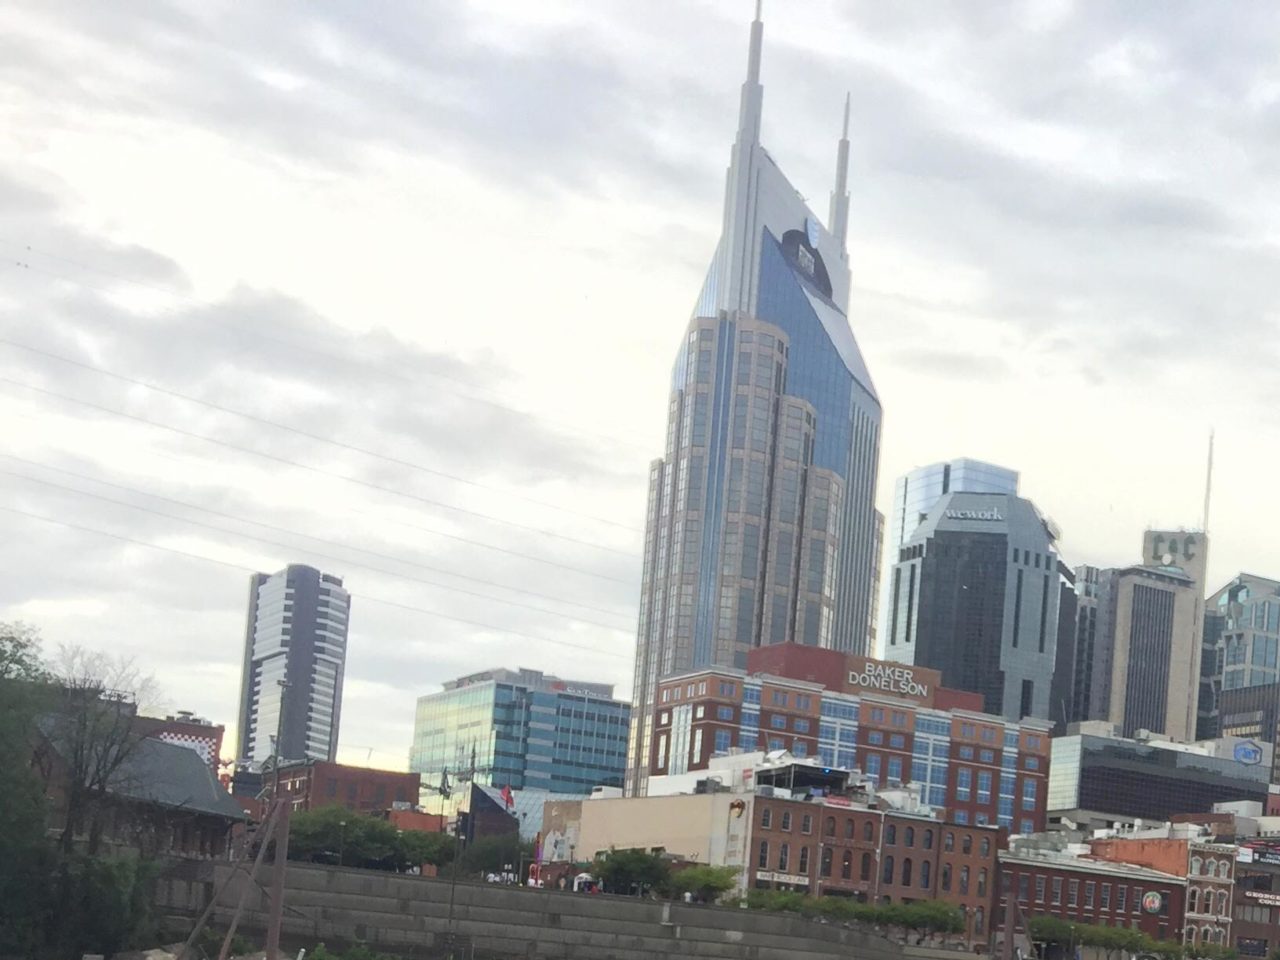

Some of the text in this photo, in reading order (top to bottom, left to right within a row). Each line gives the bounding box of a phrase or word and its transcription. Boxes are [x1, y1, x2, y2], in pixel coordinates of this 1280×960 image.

[945, 507, 1003, 521] wework
[865, 662, 914, 683] BAKER
[848, 671, 928, 697] DONELSON
